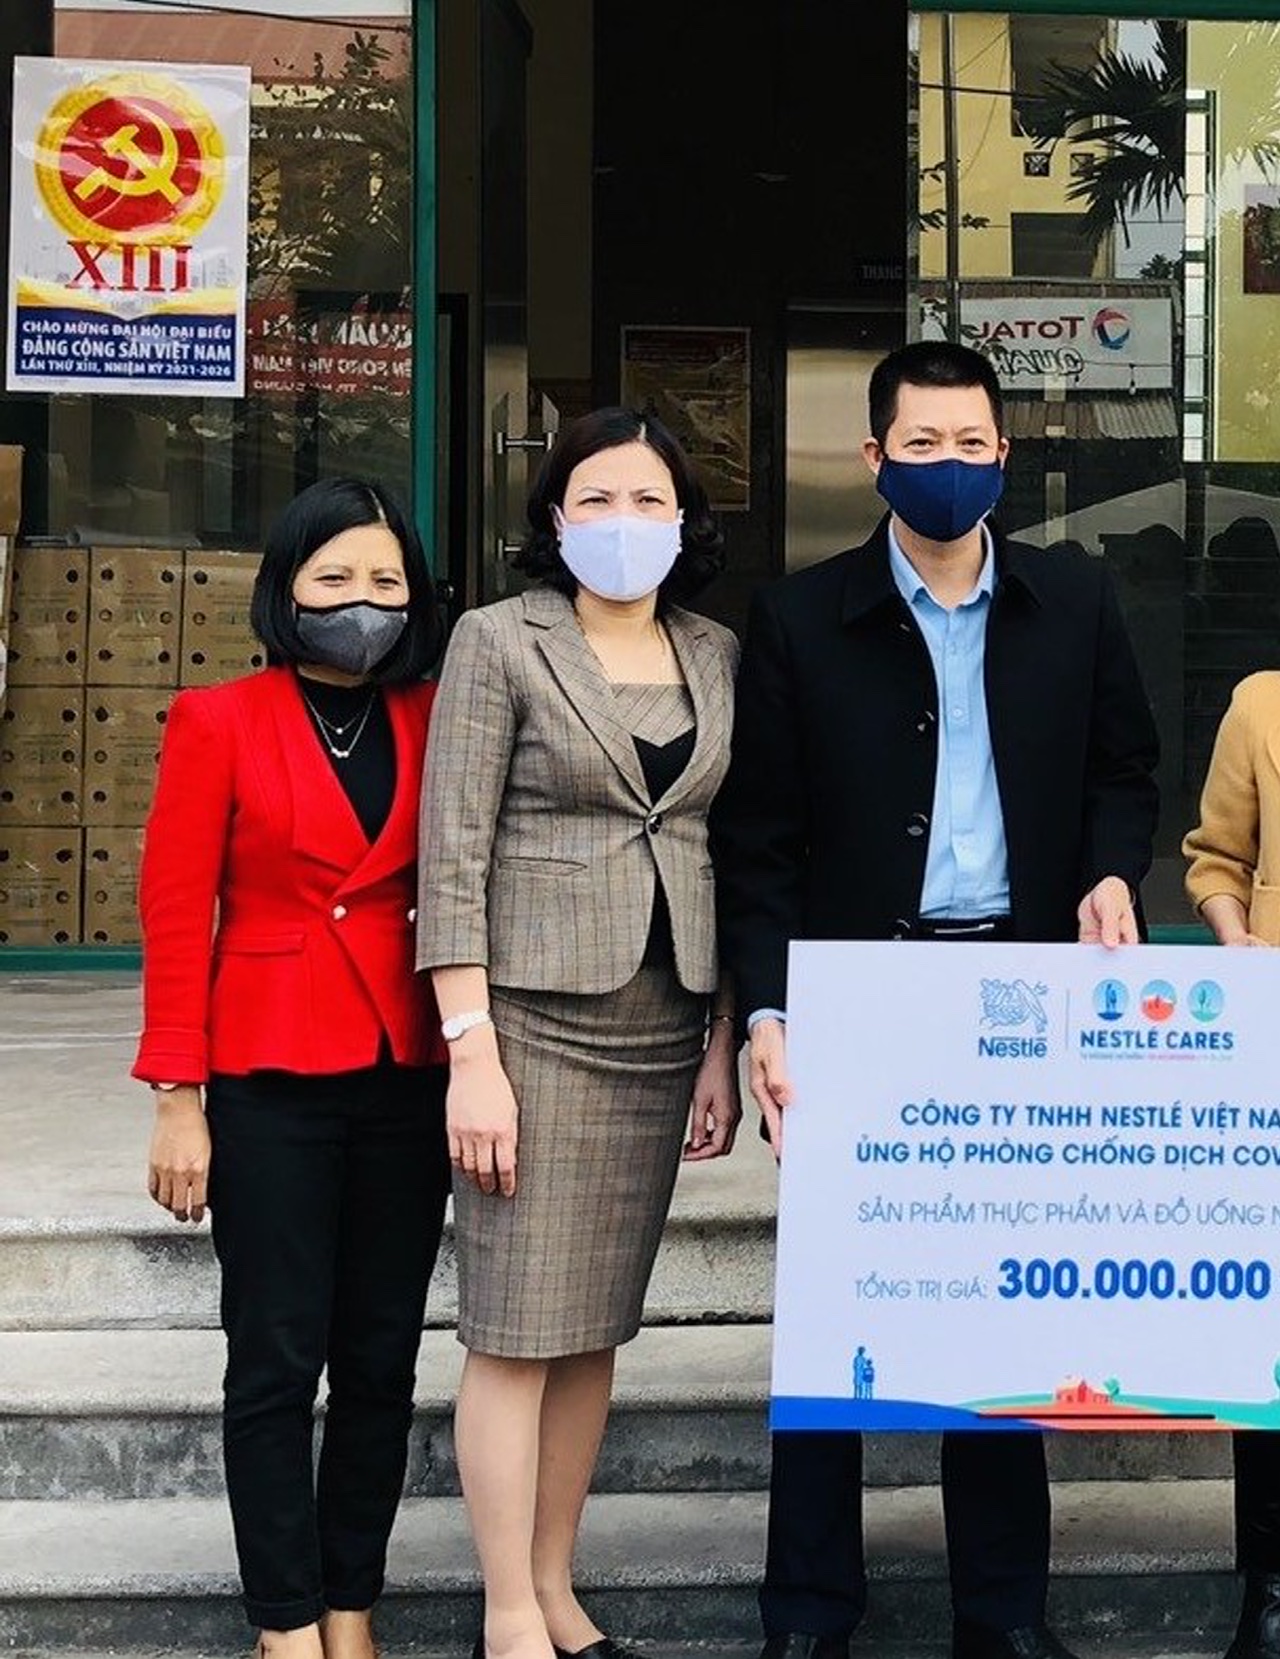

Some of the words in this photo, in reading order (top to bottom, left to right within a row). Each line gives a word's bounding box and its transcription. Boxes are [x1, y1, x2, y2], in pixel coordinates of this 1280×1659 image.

[64, 240, 193, 292] XIII
[22, 319, 61, 334] CHÀO
[64, 319, 109, 335] MỪNG
[112, 323, 138, 340] ĐẠI
[140, 323, 167, 340] HỘI
[170, 324, 194, 341] ĐẠI
[197, 323, 231, 339] BIỂU
[22, 335, 68, 356] ĐẢNG
[71, 338, 115, 362] CỘNG
[118, 337, 150, 358] SẢN
[153, 339, 190, 364] VIỆT
[194, 344, 231, 361] NAM
[21, 358, 45, 371] LẦN
[49, 358, 73, 372] THỨ
[104, 361, 145, 376] NHIỆM
[166, 363, 231, 376] 2021-2026
[978, 1036, 1048, 1058] Nestlé
[1080, 1027, 1159, 1049] NESTLÉ
[1165, 1031, 1234, 1050] CARES
[901, 1098, 981, 1126] CÔNG
[990, 1105, 1016, 1126] TY
[1026, 1106, 1092, 1127] TNHH
[1101, 1100, 1182, 1128] NESTLÉ
[1191, 1101, 1241, 1135] VIỆT
[856, 1134, 910, 1163] ỦNG
[919, 1136, 956, 1169] HỘ
[964, 1137, 1054, 1164] PHÒNG
[1062, 1136, 1155, 1164] CHỐNG
[1164, 1145, 1224, 1172] DỊCH
[858, 1196, 902, 1223] SẢN
[909, 1193, 975, 1223] PHẨM
[981, 1201, 1039, 1228] THỰC
[1046, 1193, 1110, 1223] PHẨM
[1116, 1199, 1149, 1223] VÀ
[1154, 1197, 1190, 1225] ĐỒ
[1197, 1198, 1265, 1225] UỐNG
[855, 1271, 911, 1298] TỔNG
[916, 1280, 942, 1301] TRỊ
[946, 1275, 987, 1299] GIÁ:
[998, 1258, 1271, 1299] 300.000.000
